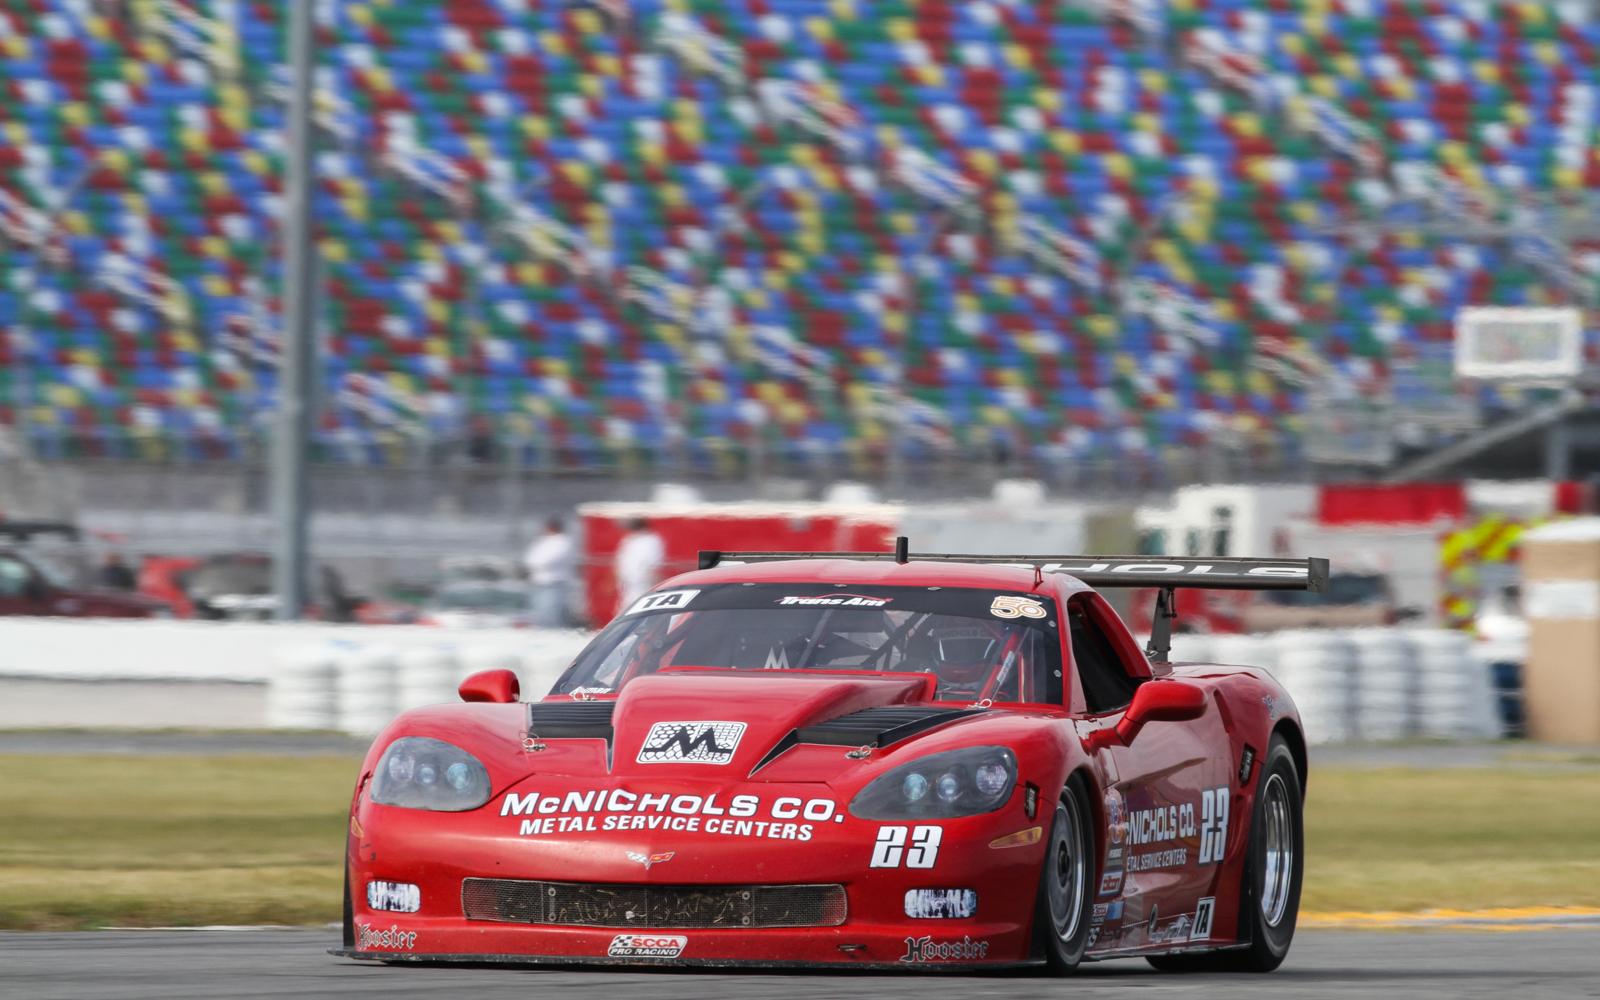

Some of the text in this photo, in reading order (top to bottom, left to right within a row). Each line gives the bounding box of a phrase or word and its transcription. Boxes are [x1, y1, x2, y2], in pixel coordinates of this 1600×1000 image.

[986, 563, 1309, 577] HOLS
[643, 594, 684, 609] TA
[780, 596, 887, 607] Trans Am
[499, 788, 845, 824] McNICHOLS CO.
[1179, 802, 1197, 838] CO.
[519, 814, 814, 842] METAL SERVICE CENTERS
[1198, 786, 1230, 864] 23
[869, 825, 943, 869] 23
[1194, 902, 1210, 935] TA
[359, 922, 418, 950] Hoosier
[631, 938, 680, 948] SCCA
[900, 935, 989, 963] Hoosier
[634, 947, 678, 956] RACING
